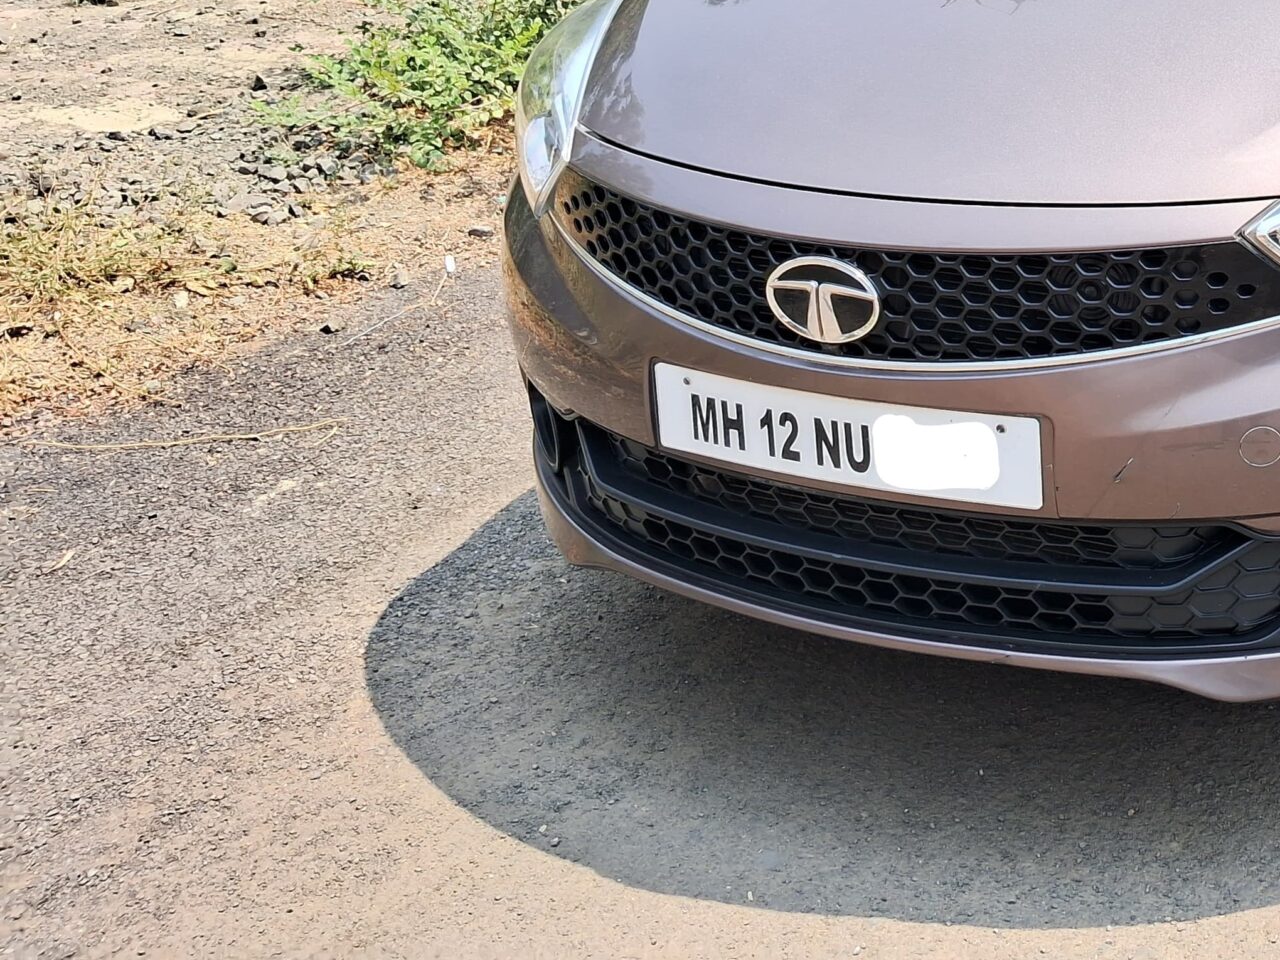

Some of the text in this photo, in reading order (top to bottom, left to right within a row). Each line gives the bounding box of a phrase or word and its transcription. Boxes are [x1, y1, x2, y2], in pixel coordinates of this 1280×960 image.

[691, 393, 871, 474] MH 12 NU
